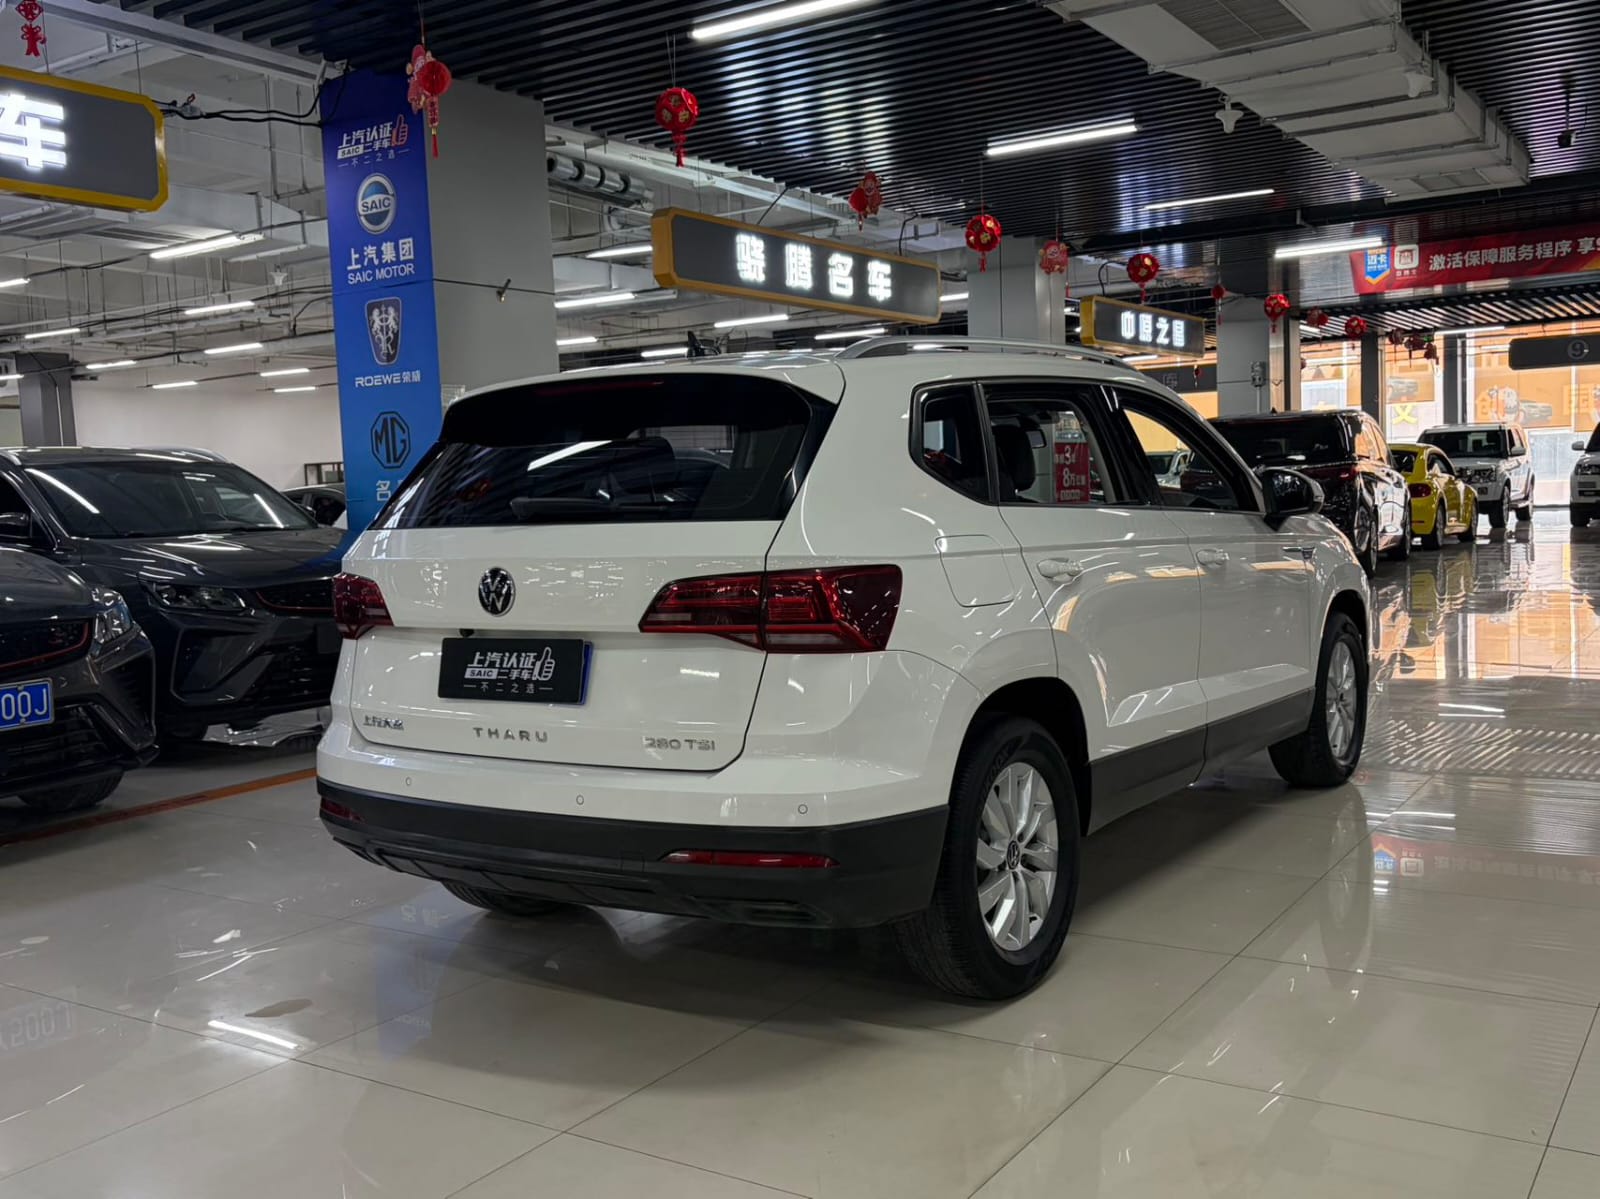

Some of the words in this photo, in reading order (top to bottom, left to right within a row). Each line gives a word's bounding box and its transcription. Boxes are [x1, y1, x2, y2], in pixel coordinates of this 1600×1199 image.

[338, 122, 393, 148] 上汽认证
[341, 147, 361, 157] SAIC
[361, 197, 391, 213] SAIC
[347, 237, 414, 270] 上汽集团
[1429, 240, 1572, 271] 激活保障服务程序
[347, 269, 373, 285] SAIC
[375, 263, 415, 280] MOTOR
[467, 652, 538, 669] 上汽认证
[469, 669, 493, 678] SAIC
[497, 669, 532, 680] 二手车
[480, 682, 535, 694] 不二之选
[473, 727, 548, 742] THARU
[644, 736, 681, 750] 280
[684, 738, 716, 751] TSI
